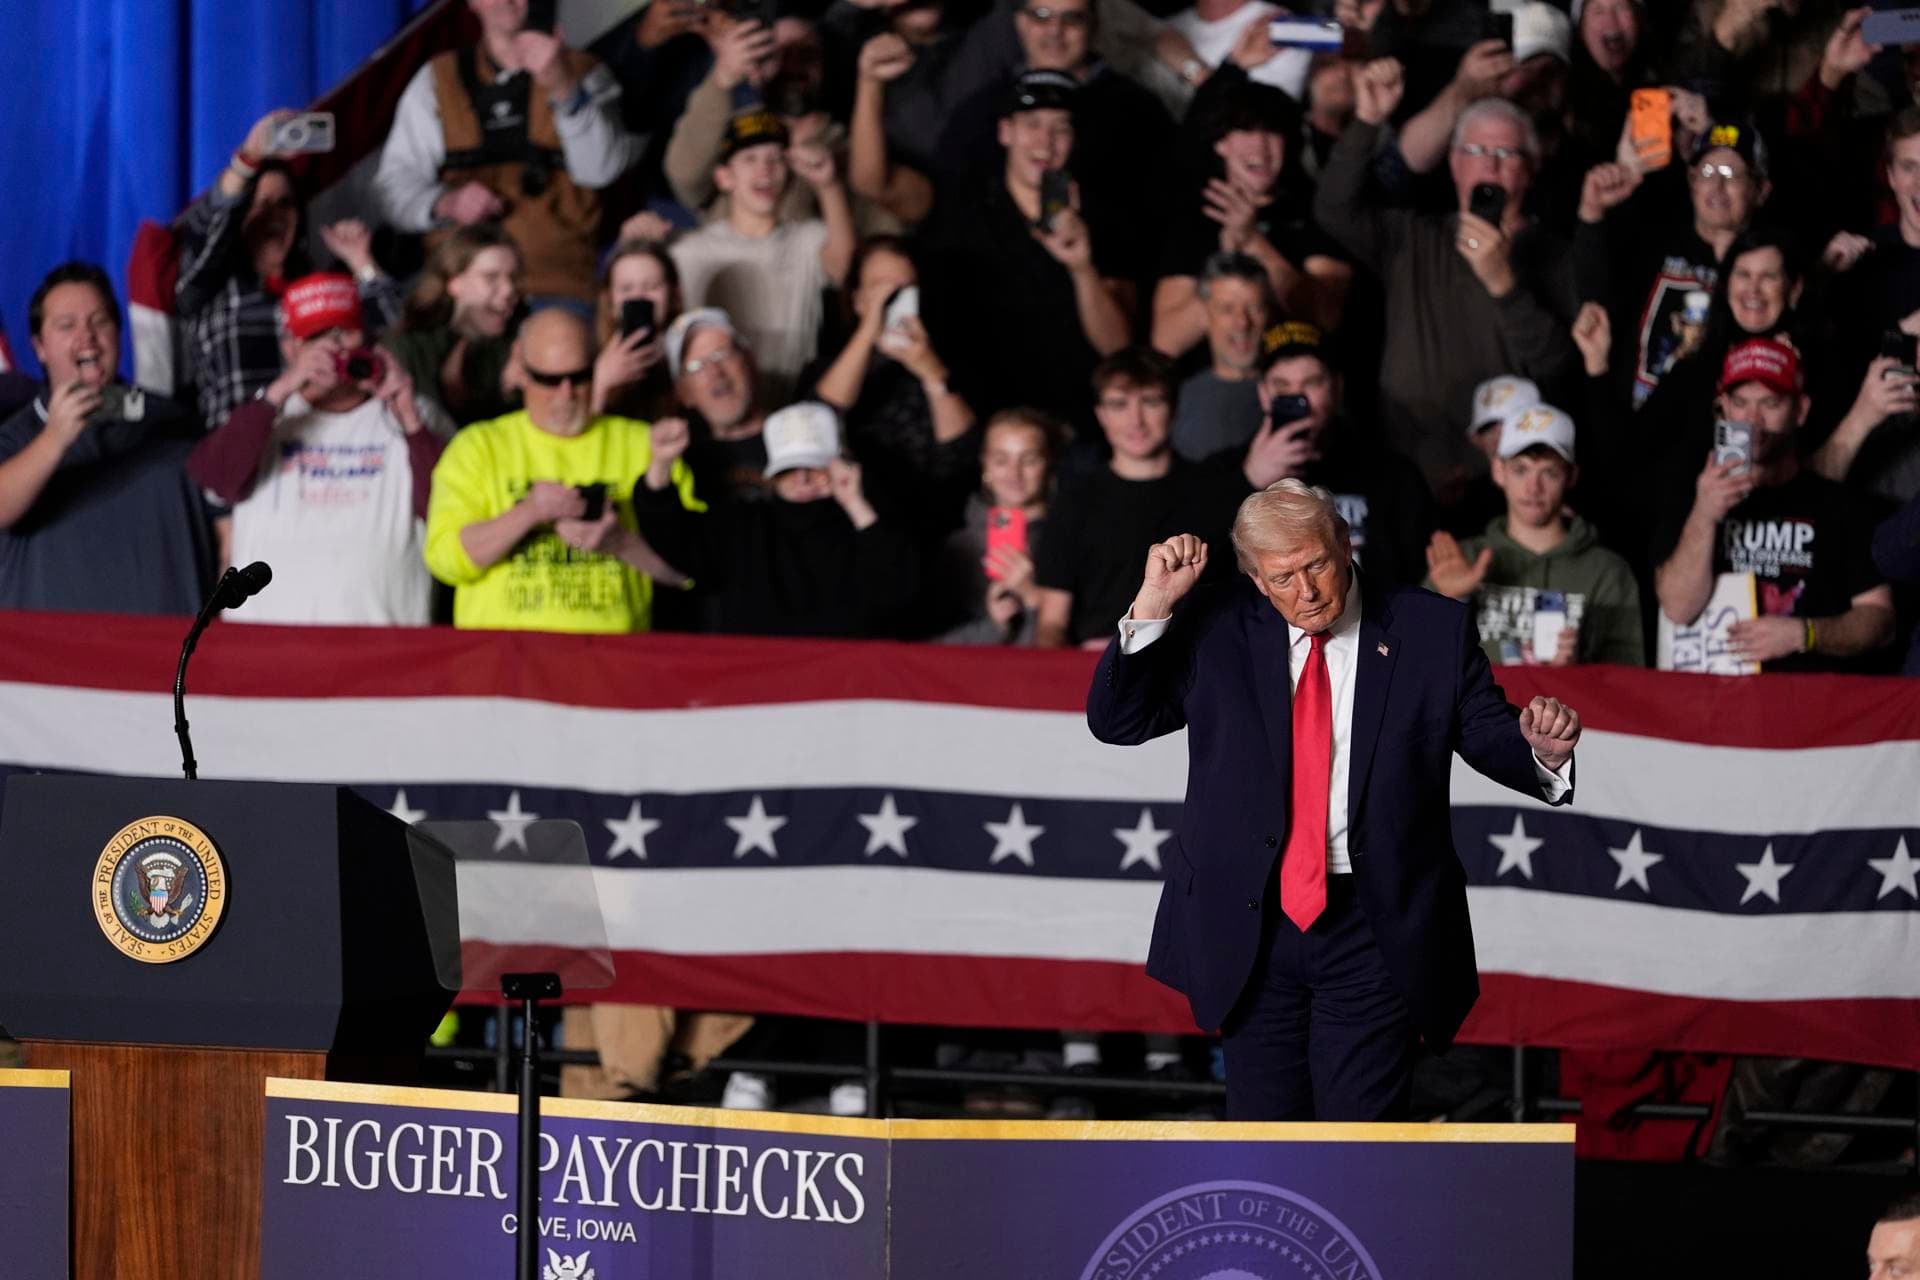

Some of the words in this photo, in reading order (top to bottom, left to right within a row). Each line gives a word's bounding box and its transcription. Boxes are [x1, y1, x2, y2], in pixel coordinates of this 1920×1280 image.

[1721, 518, 1816, 553] RUMP
[163, 823, 176, 832] OF
[177, 827, 195, 842] THE
[98, 821, 160, 884] PRESIDENT
[196, 840, 221, 900] UNITED
[99, 891, 109, 909] THE
[103, 912, 113, 925] OF
[168, 912, 214, 956] STATES
[112, 924, 145, 955] SEAL
[283, 1114, 508, 1200] BIGGER
[501, 1213, 571, 1242] CVE,
[575, 1218, 637, 1243] IOWA
[1238, 1198, 1270, 1218] OF
[1276, 1205, 1320, 1241] THE
